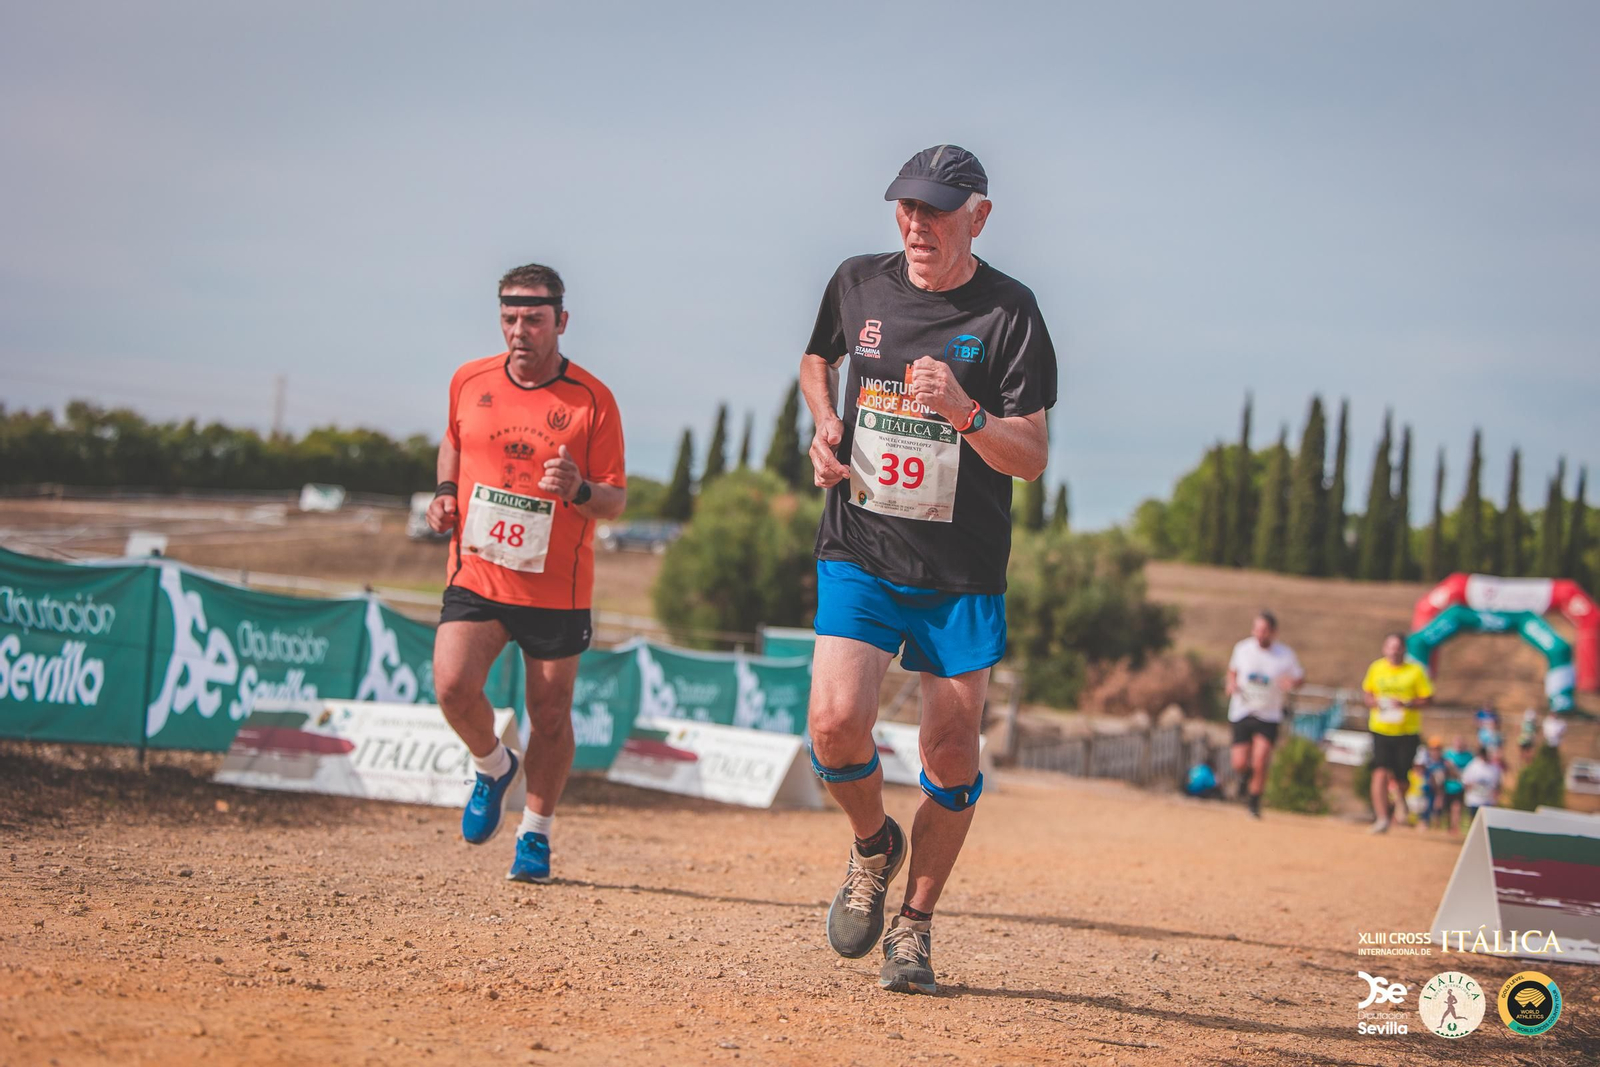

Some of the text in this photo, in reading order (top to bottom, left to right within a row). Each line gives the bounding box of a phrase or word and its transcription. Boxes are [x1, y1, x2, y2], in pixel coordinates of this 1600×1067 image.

[855, 345, 881, 356] STAMINA
[953, 344, 980, 359] TBF
[863, 394, 898, 410] JORGE
[490, 426, 555, 447] SANTIPONCE
[881, 418, 932, 437] ITÁLICA
[878, 453, 925, 490] 39
[489, 519, 525, 548] 48
